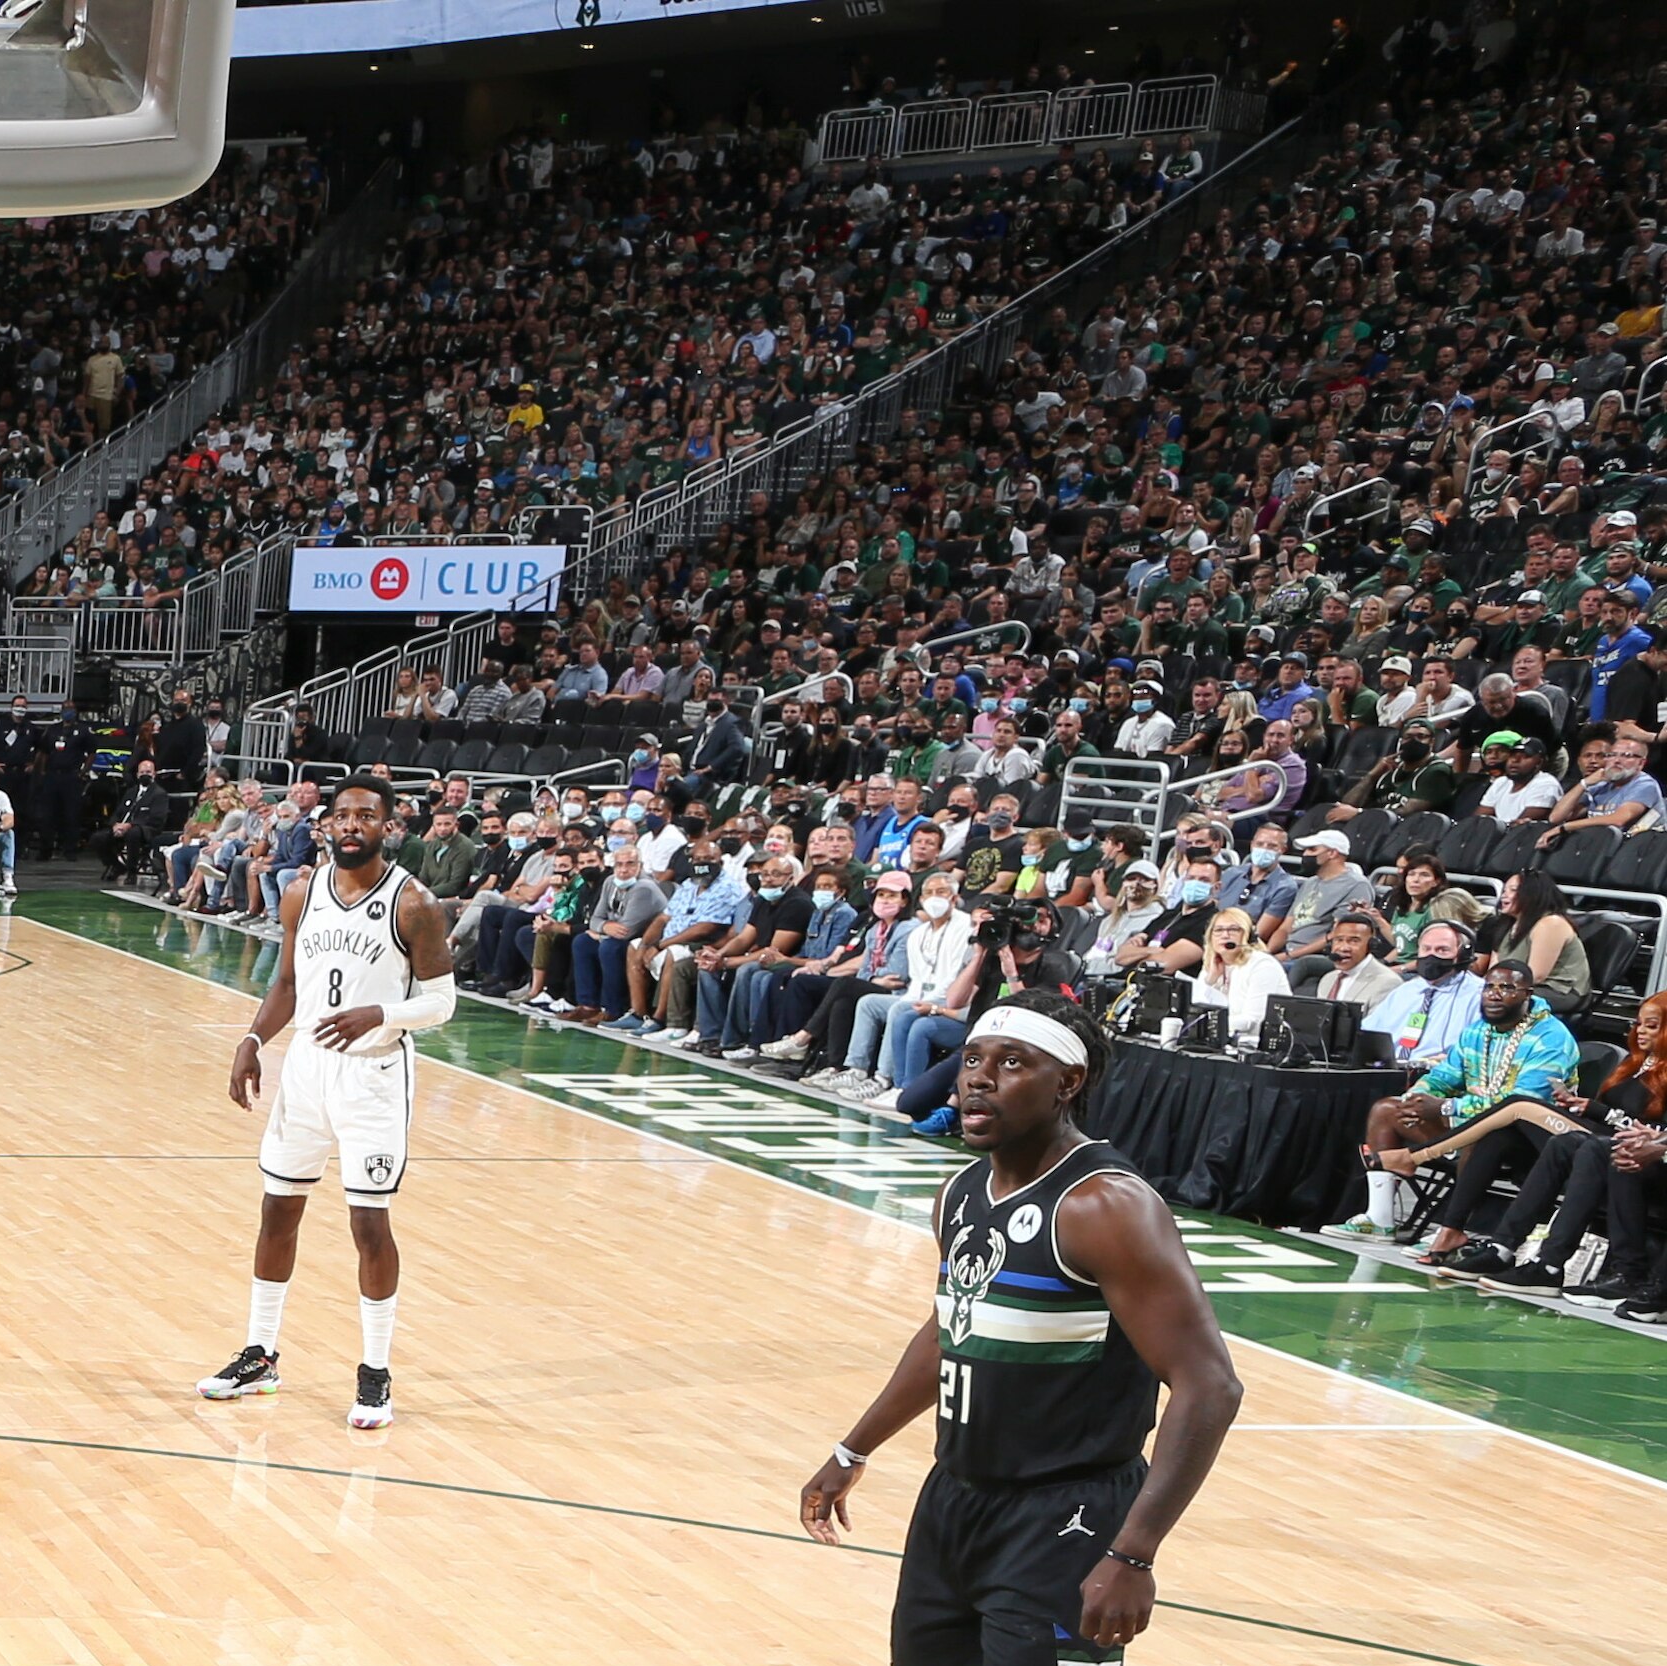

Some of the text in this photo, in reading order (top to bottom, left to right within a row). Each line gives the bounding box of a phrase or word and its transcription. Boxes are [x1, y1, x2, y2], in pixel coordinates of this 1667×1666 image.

[313, 561, 540, 595] BMO CLUB
[302, 928, 386, 965] BROOKLYN
[328, 968, 343, 1008] 8
[366, 1156, 394, 1169] NETS
[938, 1358, 973, 1425] 21
